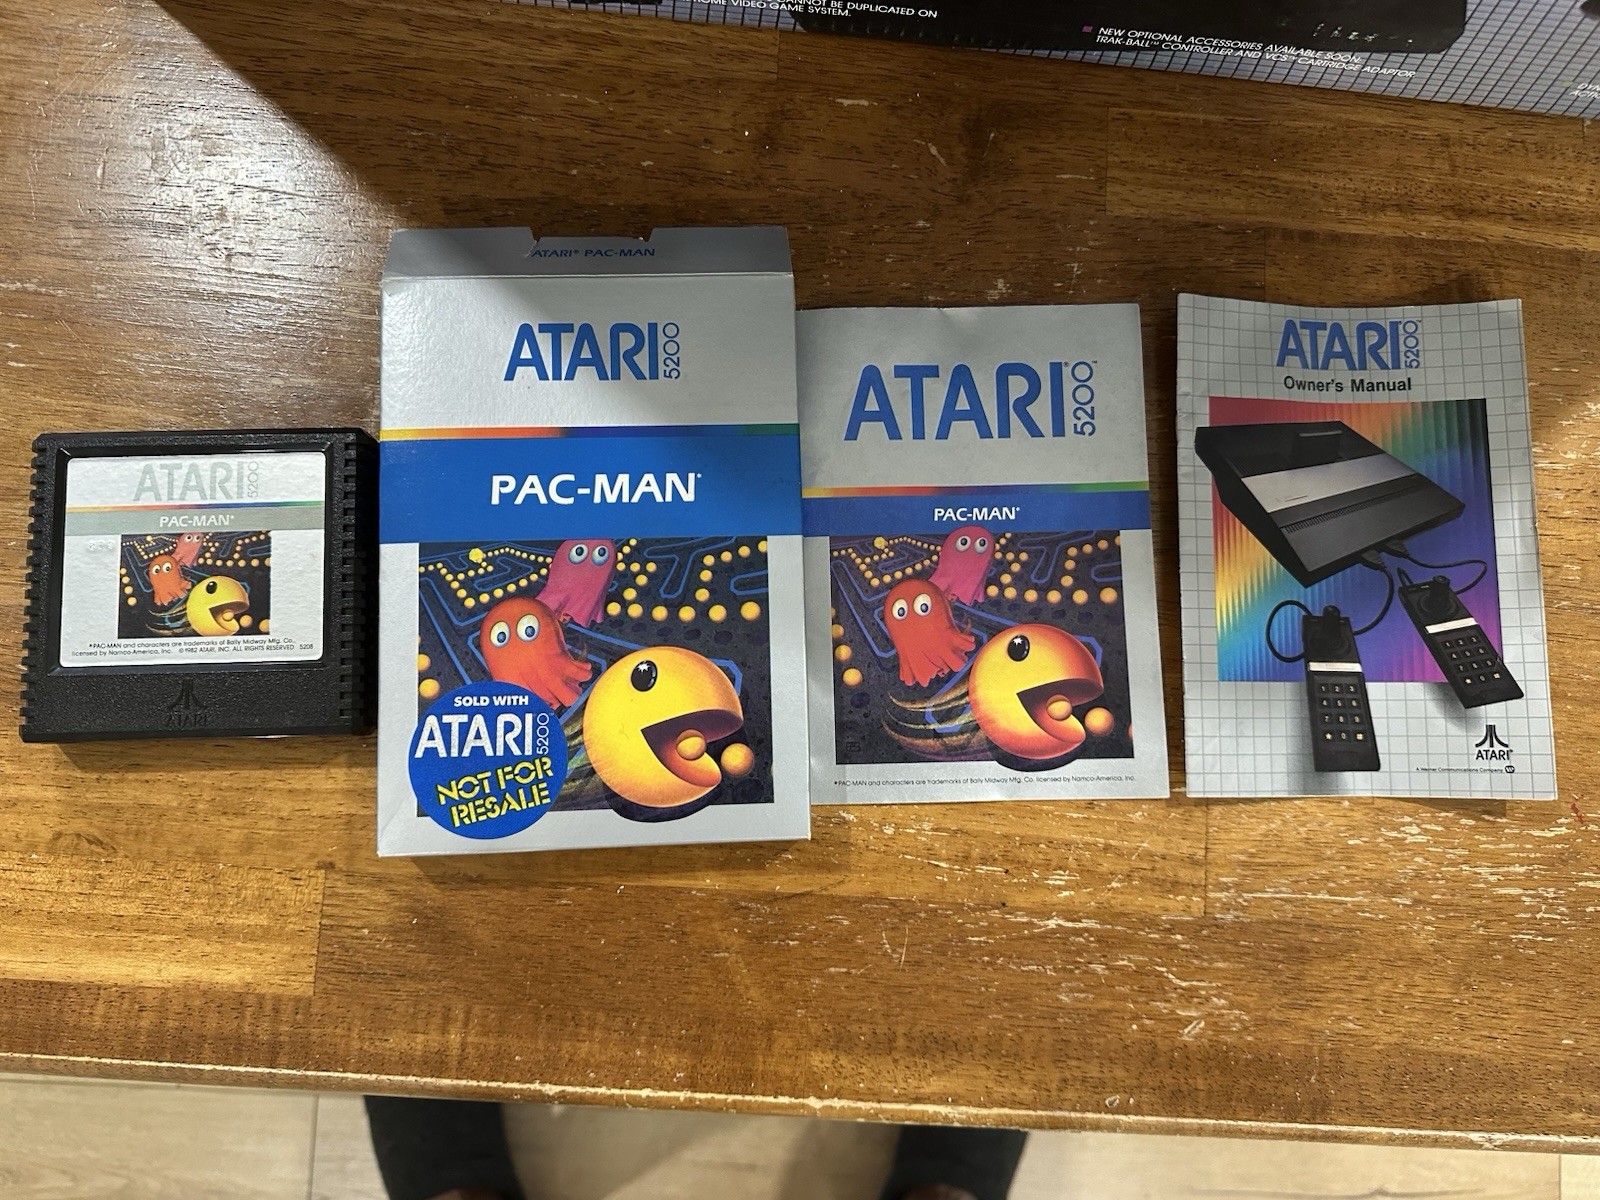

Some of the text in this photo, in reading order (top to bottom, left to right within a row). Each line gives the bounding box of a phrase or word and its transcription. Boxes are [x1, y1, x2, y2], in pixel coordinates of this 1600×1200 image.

[731, 0, 767, 9] VIDEO
[769, 2, 805, 13] GAME
[808, 6, 851, 17] SYSTEM.
[831, 1, 844, 9] BE
[846, 2, 915, 16] DUPLICATED
[918, 9, 938, 18] ON
[1098, 27, 1362, 63] NEW OPTIONAL ACCESSORIES AVAILABLE SOON:
[1162, 42, 1232, 56] CONTROLLER
[1235, 50, 1262, 60] AND
[1298, 57, 1361, 71] CARTRIDGE
[584, 248, 656, 258] PAC-MAN
[503, 322, 682, 381] ATARI 5200
[1283, 375, 1411, 393] Owner's Manual
[132, 460, 260, 502] ATARI 5200
[243, 638, 267, 646] Midway
[454, 695, 529, 707] SOLD WITH
[414, 713, 533, 758] ATARI
[436, 756, 555, 806] NOT FOR
[927, 777, 962, 785] trademarks
[970, 777, 984, 785] Bally
[1062, 775, 1070, 783] by
[450, 782, 551, 828] RESALE
